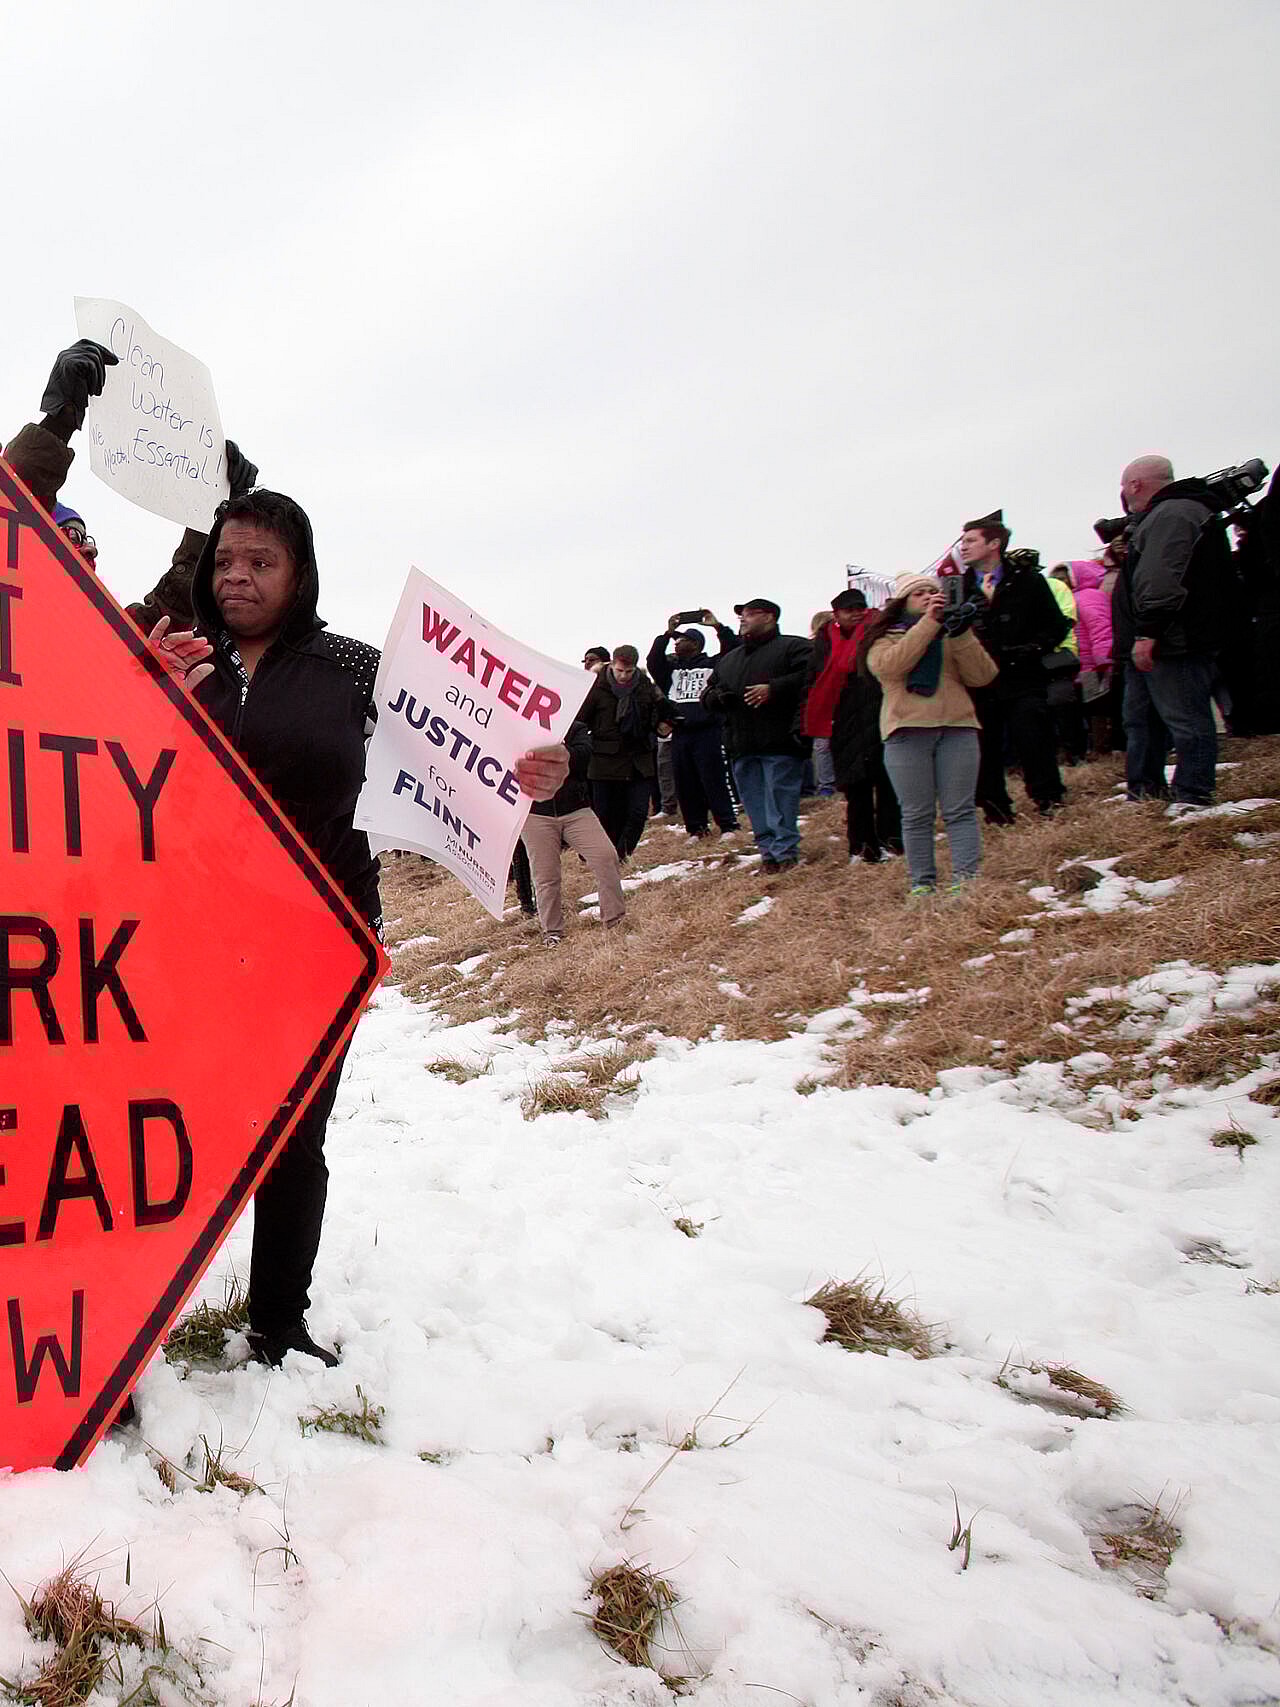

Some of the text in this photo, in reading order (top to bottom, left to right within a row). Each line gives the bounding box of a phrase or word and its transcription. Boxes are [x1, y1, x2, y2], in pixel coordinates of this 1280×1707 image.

[132, 382, 193, 431] Water
[422, 602, 562, 732] WATER
[445, 683, 494, 729] and
[388, 688, 521, 806] JUSTICE
[428, 765, 457, 798] for
[392, 769, 481, 850] FLINT
[444, 843, 496, 894] Association
[458, 845, 496, 887] NURSES
